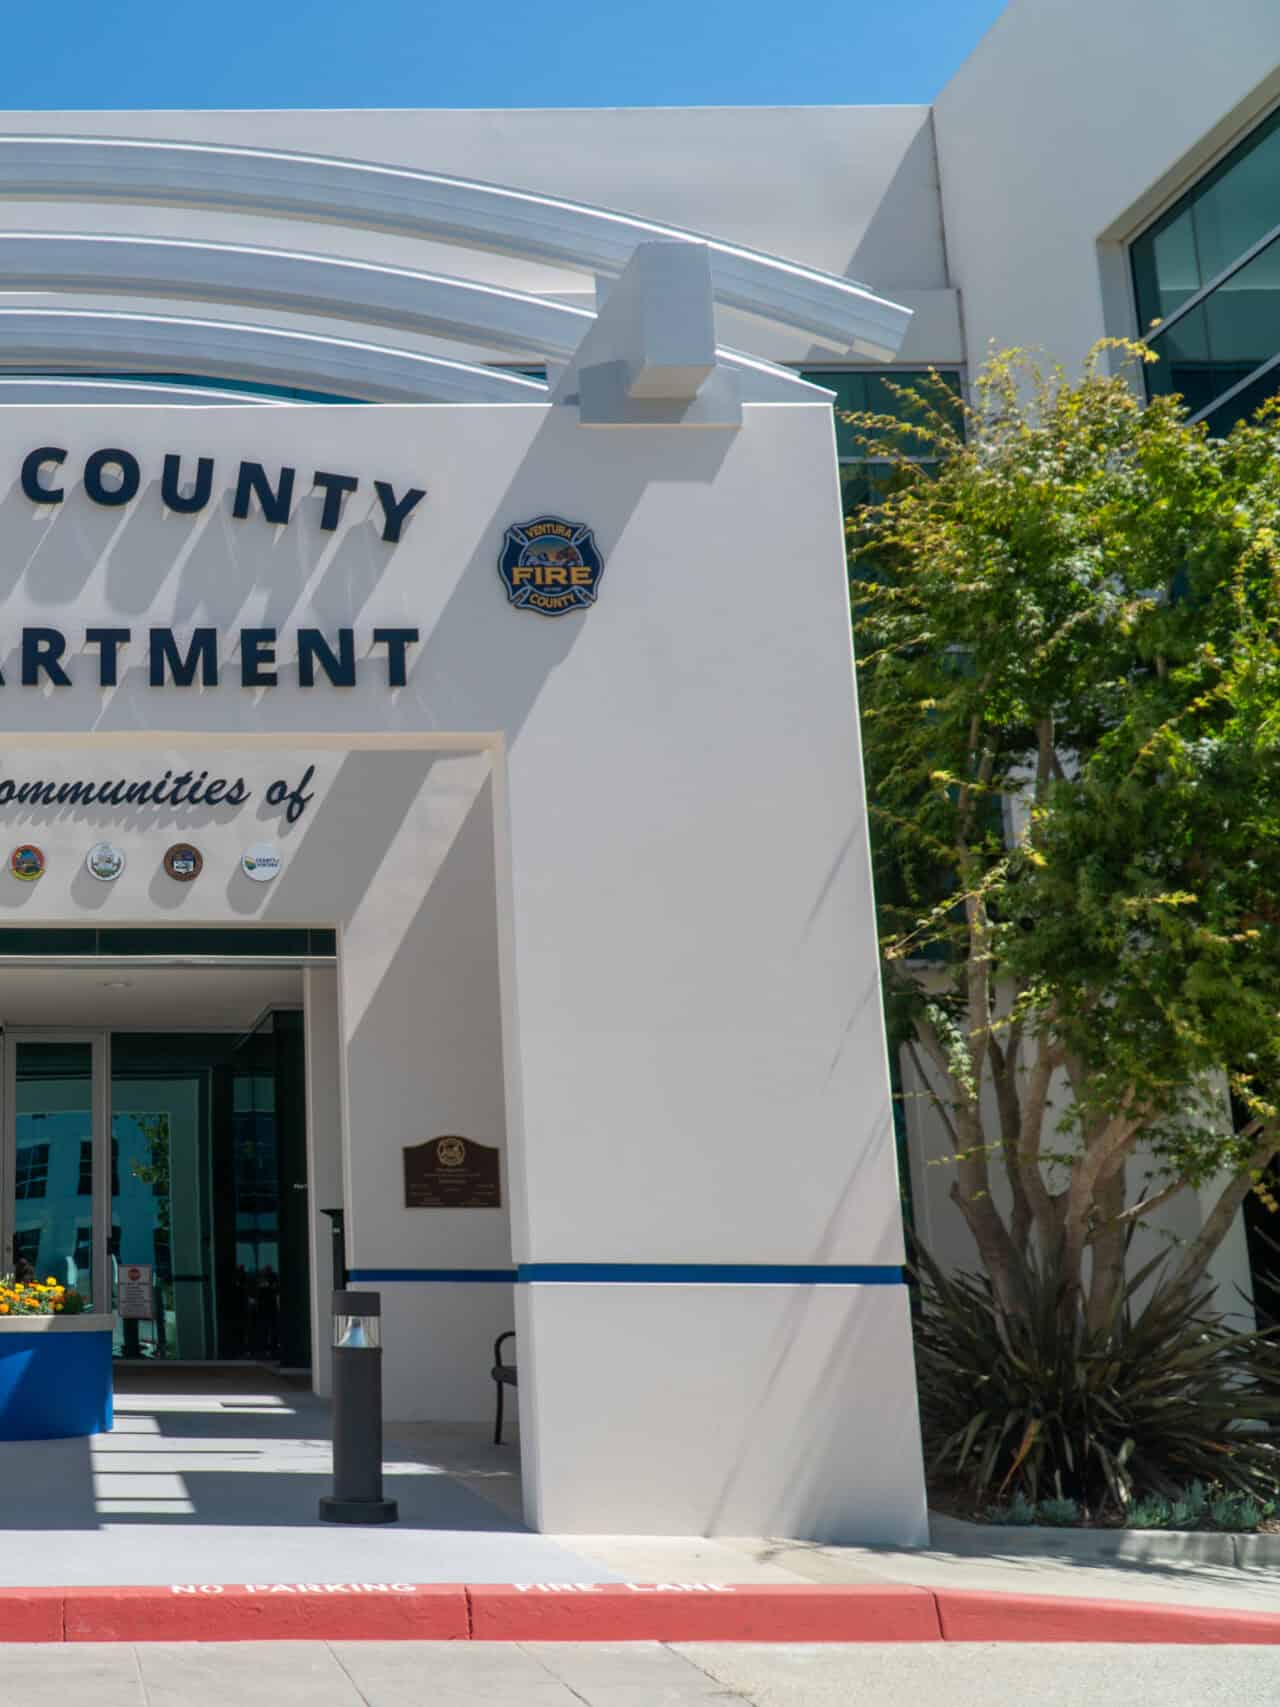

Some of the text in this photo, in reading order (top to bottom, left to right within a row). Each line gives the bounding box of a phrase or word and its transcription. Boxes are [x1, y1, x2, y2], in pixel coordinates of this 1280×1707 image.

[20, 446, 428, 545] COUNTY
[525, 523, 573, 539] VENTURA
[511, 566, 594, 585] FIRE
[528, 592, 577, 609] COUNTY
[264, 763, 316, 825] of
[171, 1583, 224, 1594] NO
[245, 1583, 417, 1594] PARKING
